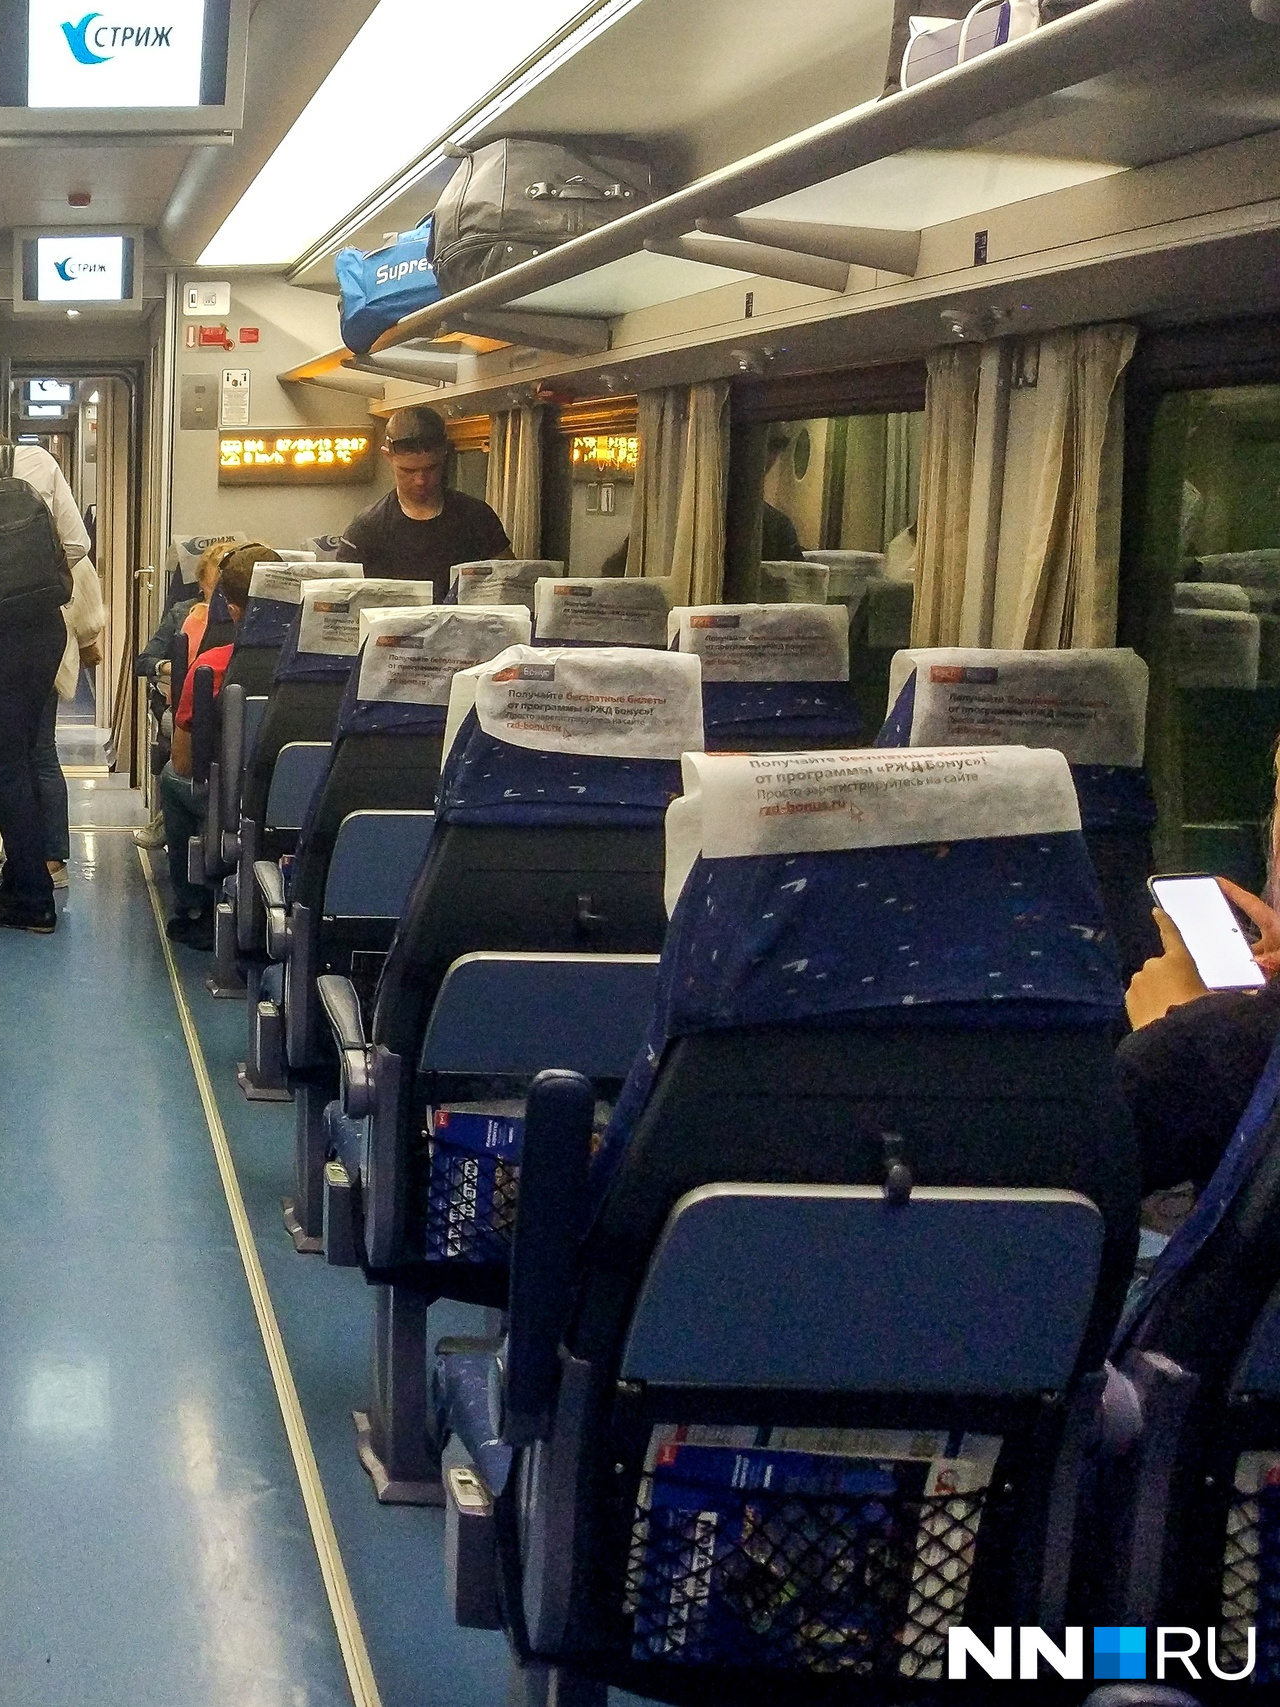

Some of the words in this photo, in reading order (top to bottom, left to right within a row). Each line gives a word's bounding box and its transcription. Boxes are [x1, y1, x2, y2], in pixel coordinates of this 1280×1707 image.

[94, 26, 173, 48] СТРИЖ
[69, 263, 107, 274] СТРИЖ
[376, 258, 434, 285] Supre
[508, 689, 564, 700] Получайте
[566, 691, 625, 703] бесплатные
[749, 756, 835, 769] Получайте
[755, 773, 773, 785] от
[776, 766, 871, 785] программы
[876, 760, 924, 774] «РЖД
[925, 756, 987, 771] Бонус»!
[757, 787, 800, 800] Просто
[943, 771, 979, 784] сайте
